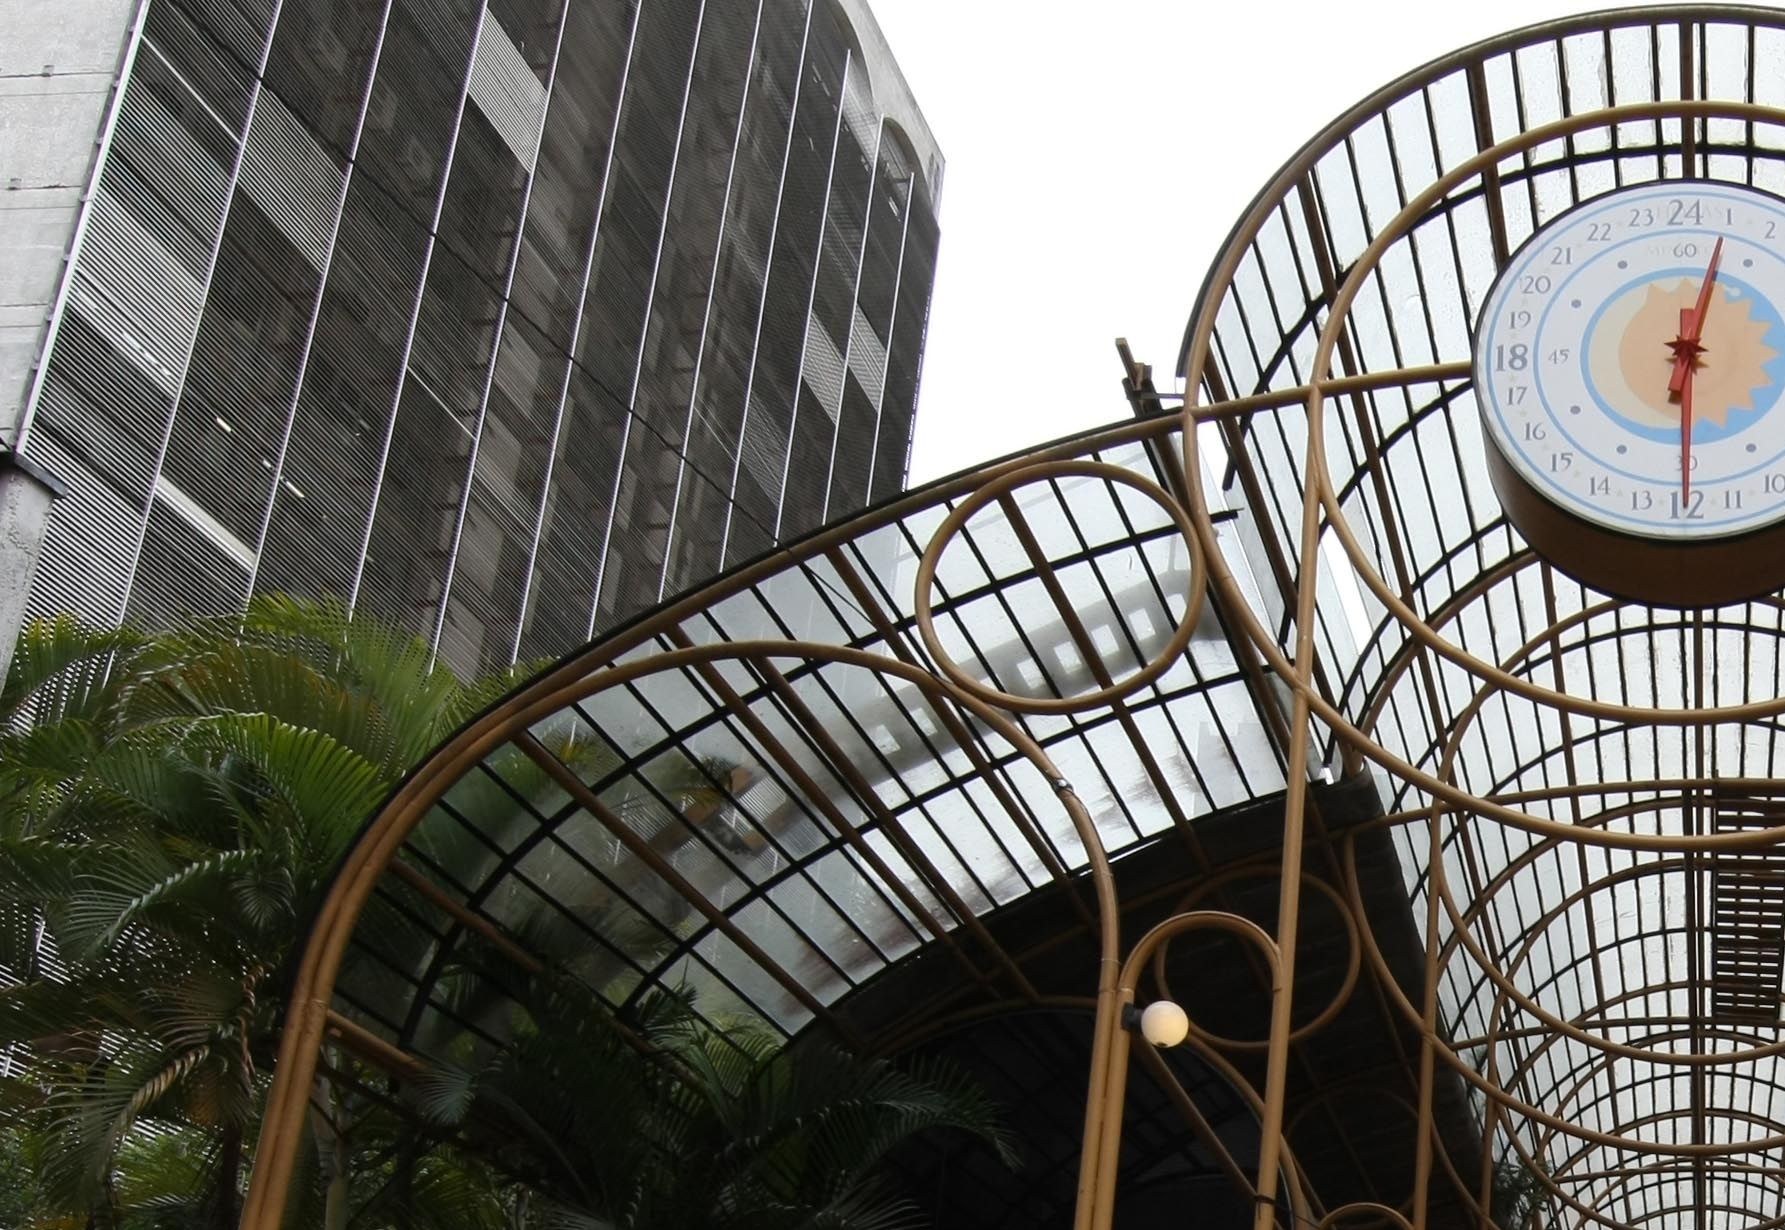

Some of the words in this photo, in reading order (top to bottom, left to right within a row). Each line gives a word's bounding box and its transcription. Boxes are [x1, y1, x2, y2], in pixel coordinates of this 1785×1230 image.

[1629, 208, 1654, 227] 23
[1667, 199, 1704, 226] 24
[1726, 208, 1733, 226] 1
[1587, 223, 1612, 241] 22
[1764, 221, 1776, 240] 2
[1551, 247, 1571, 265] 21
[1673, 242, 1697, 258] 60
[1522, 275, 1551, 294] 20
[1509, 311, 1531, 329] 19
[1496, 344, 1528, 372] 18
[1548, 348, 1570, 365] 45
[1508, 386, 1528, 406] 17
[1525, 422, 1546, 441] 16
[1551, 452, 1574, 472] 15
[1590, 475, 1611, 496] 14
[1631, 490, 1653, 511] 13
[1670, 490, 1705, 519] 12
[1724, 490, 1743, 509] 11
